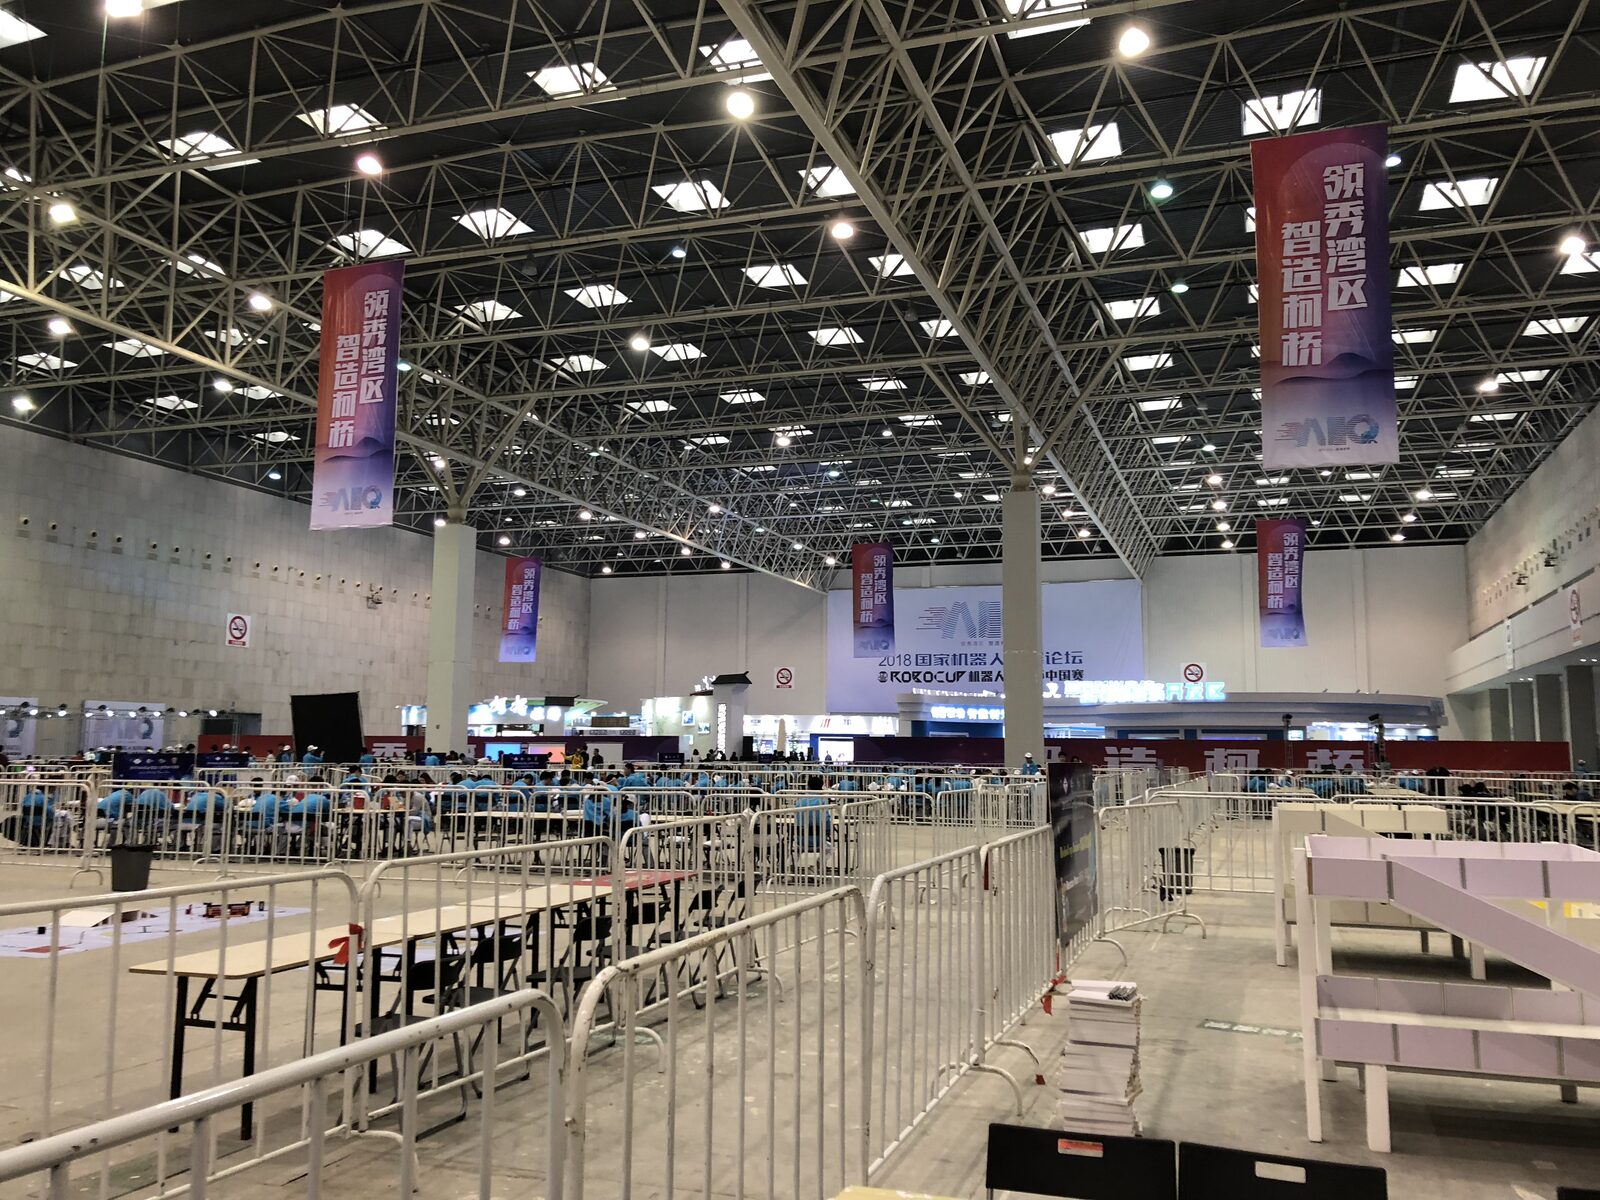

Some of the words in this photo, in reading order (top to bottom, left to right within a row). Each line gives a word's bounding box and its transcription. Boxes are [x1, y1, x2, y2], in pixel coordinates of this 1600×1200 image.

[1281, 220, 1324, 367] 智造柯桥
[1322, 162, 1368, 312] 领秀湾区
[328, 333, 361, 448] 智造柯桥
[359, 289, 390, 404] 领秀湾区
